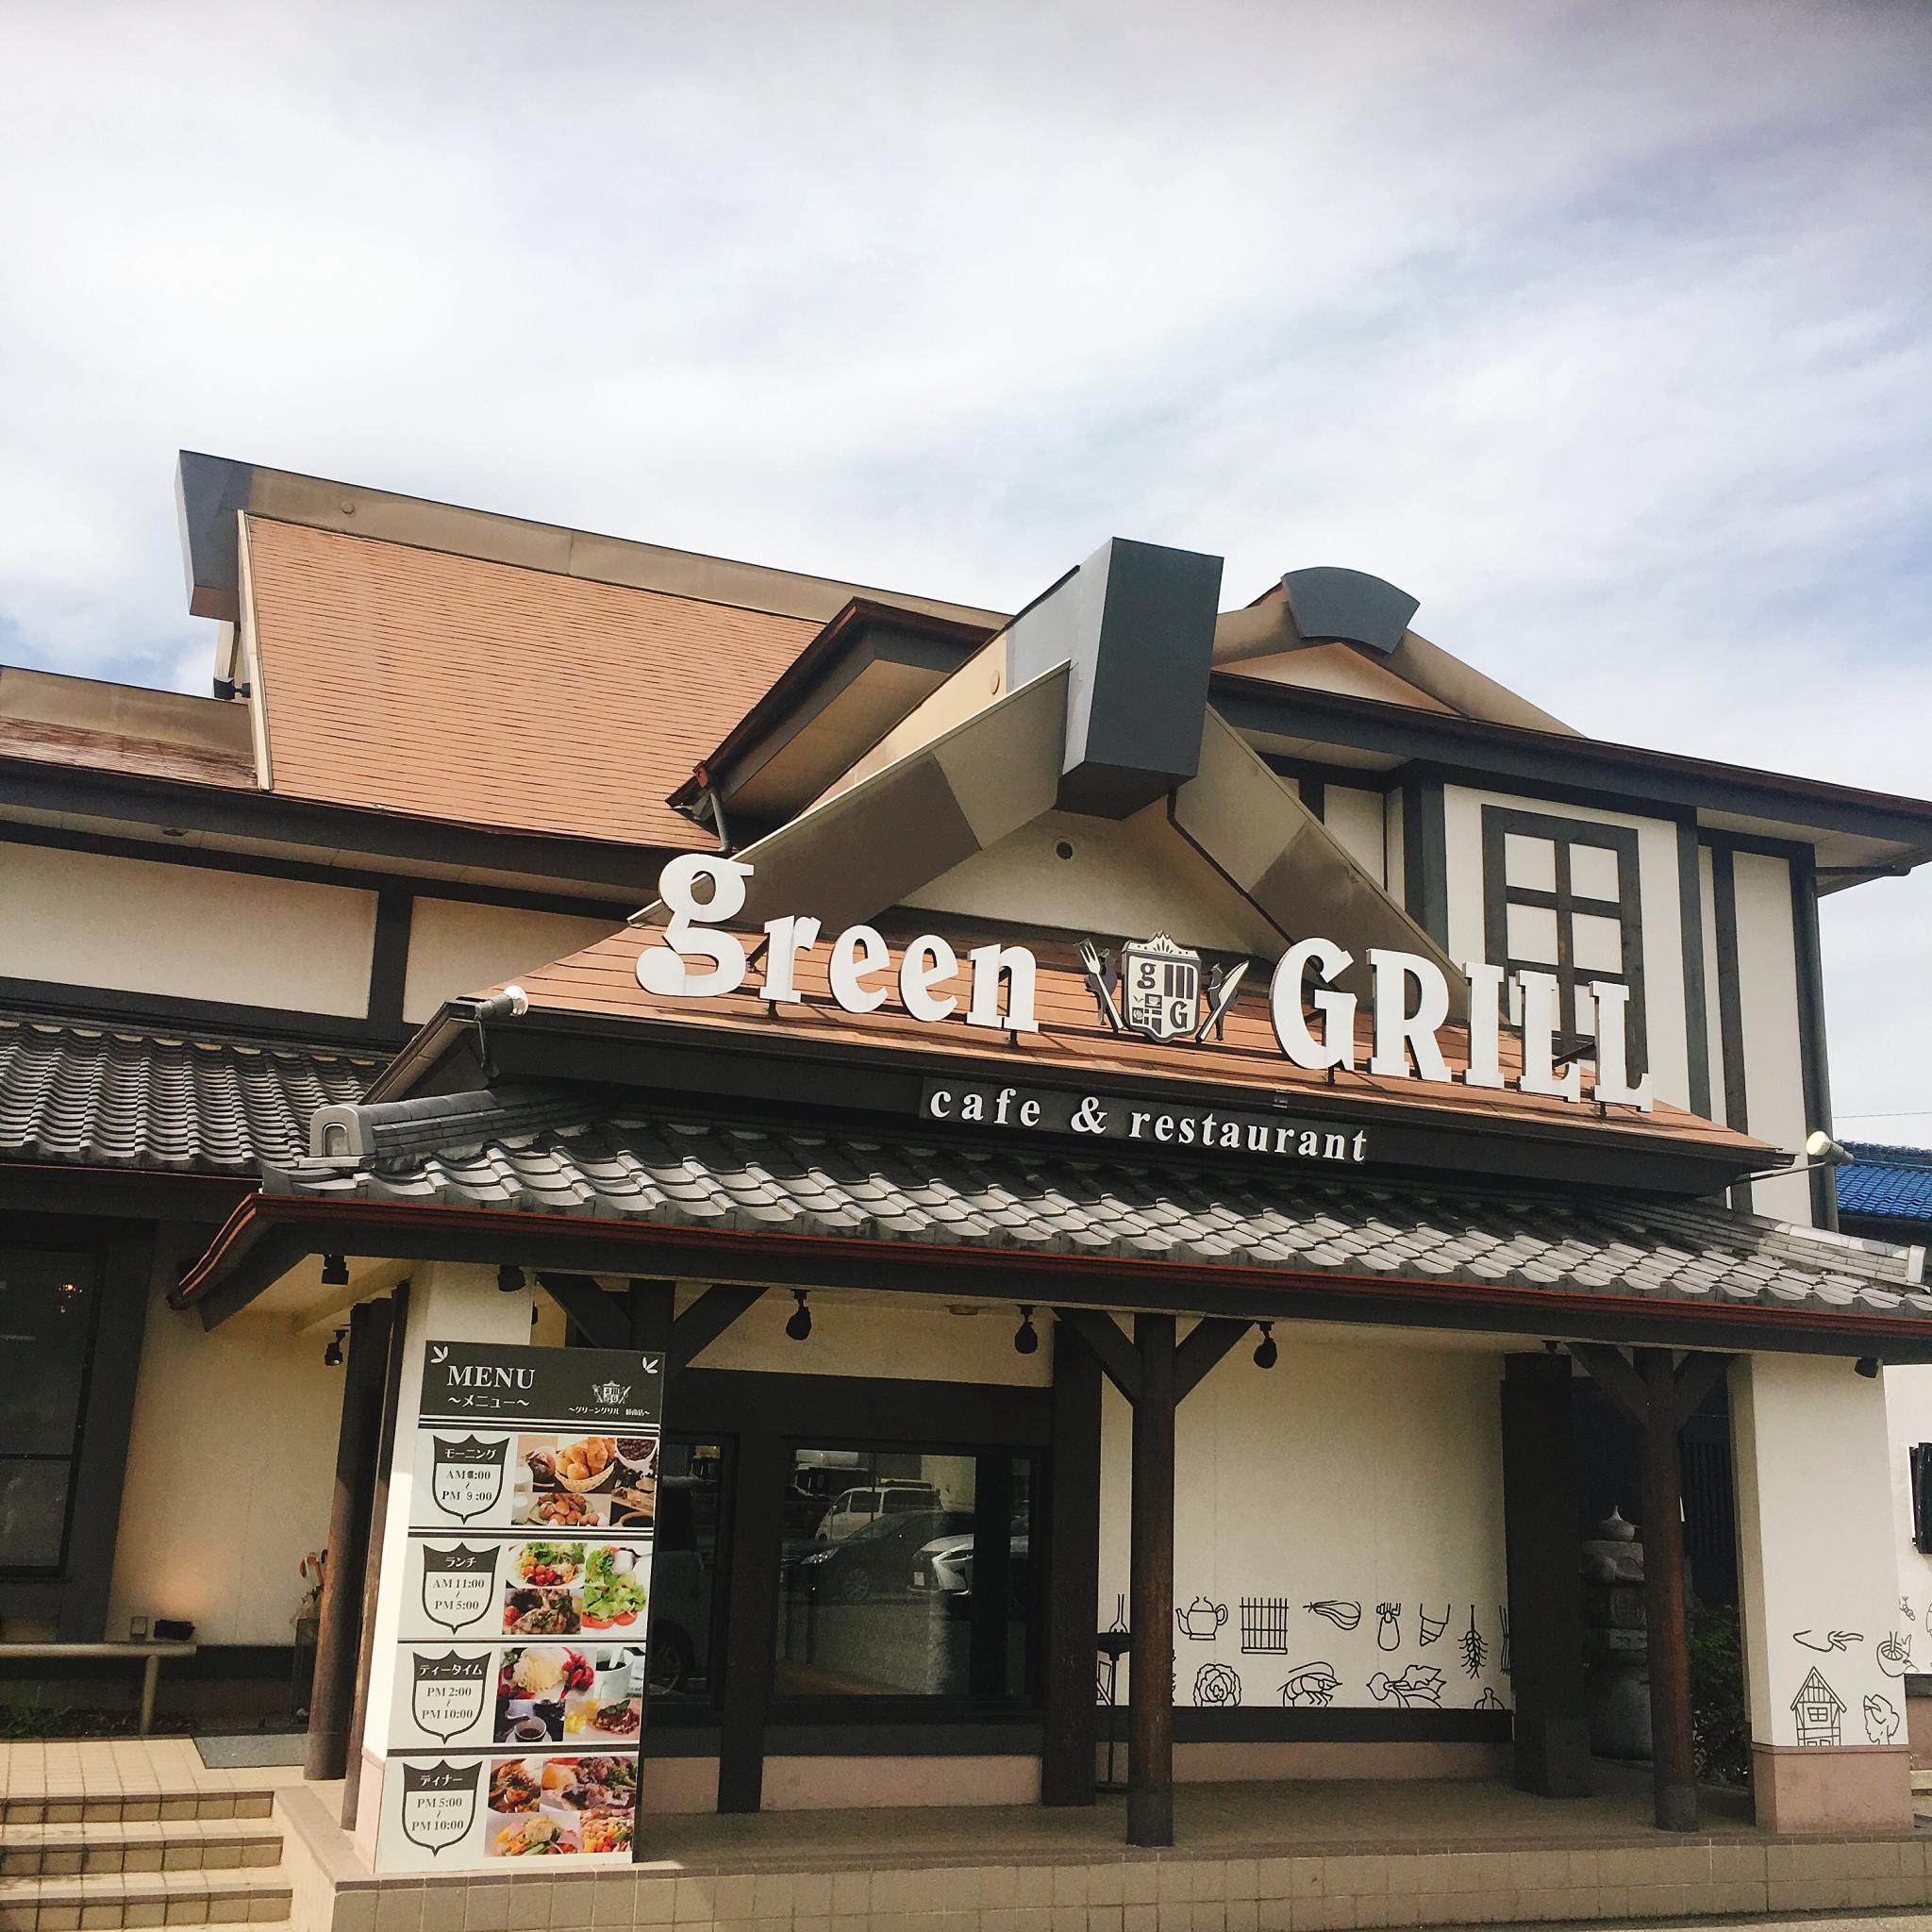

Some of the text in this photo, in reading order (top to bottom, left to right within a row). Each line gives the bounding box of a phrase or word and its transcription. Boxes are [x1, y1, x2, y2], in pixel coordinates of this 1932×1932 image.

[635, 853, 1654, 1113] green GRILL
[929, 1088, 1368, 1162] cafe & restaurant
[446, 1365, 536, 1390] MENU
[444, 1448, 497, 1460] モーニング
[441, 1491, 460, 1500] PM
[445, 1557, 476, 1568] ランチ
[419, 1663, 483, 1675] ティータイム
[420, 1774, 463, 1787] ディナー
